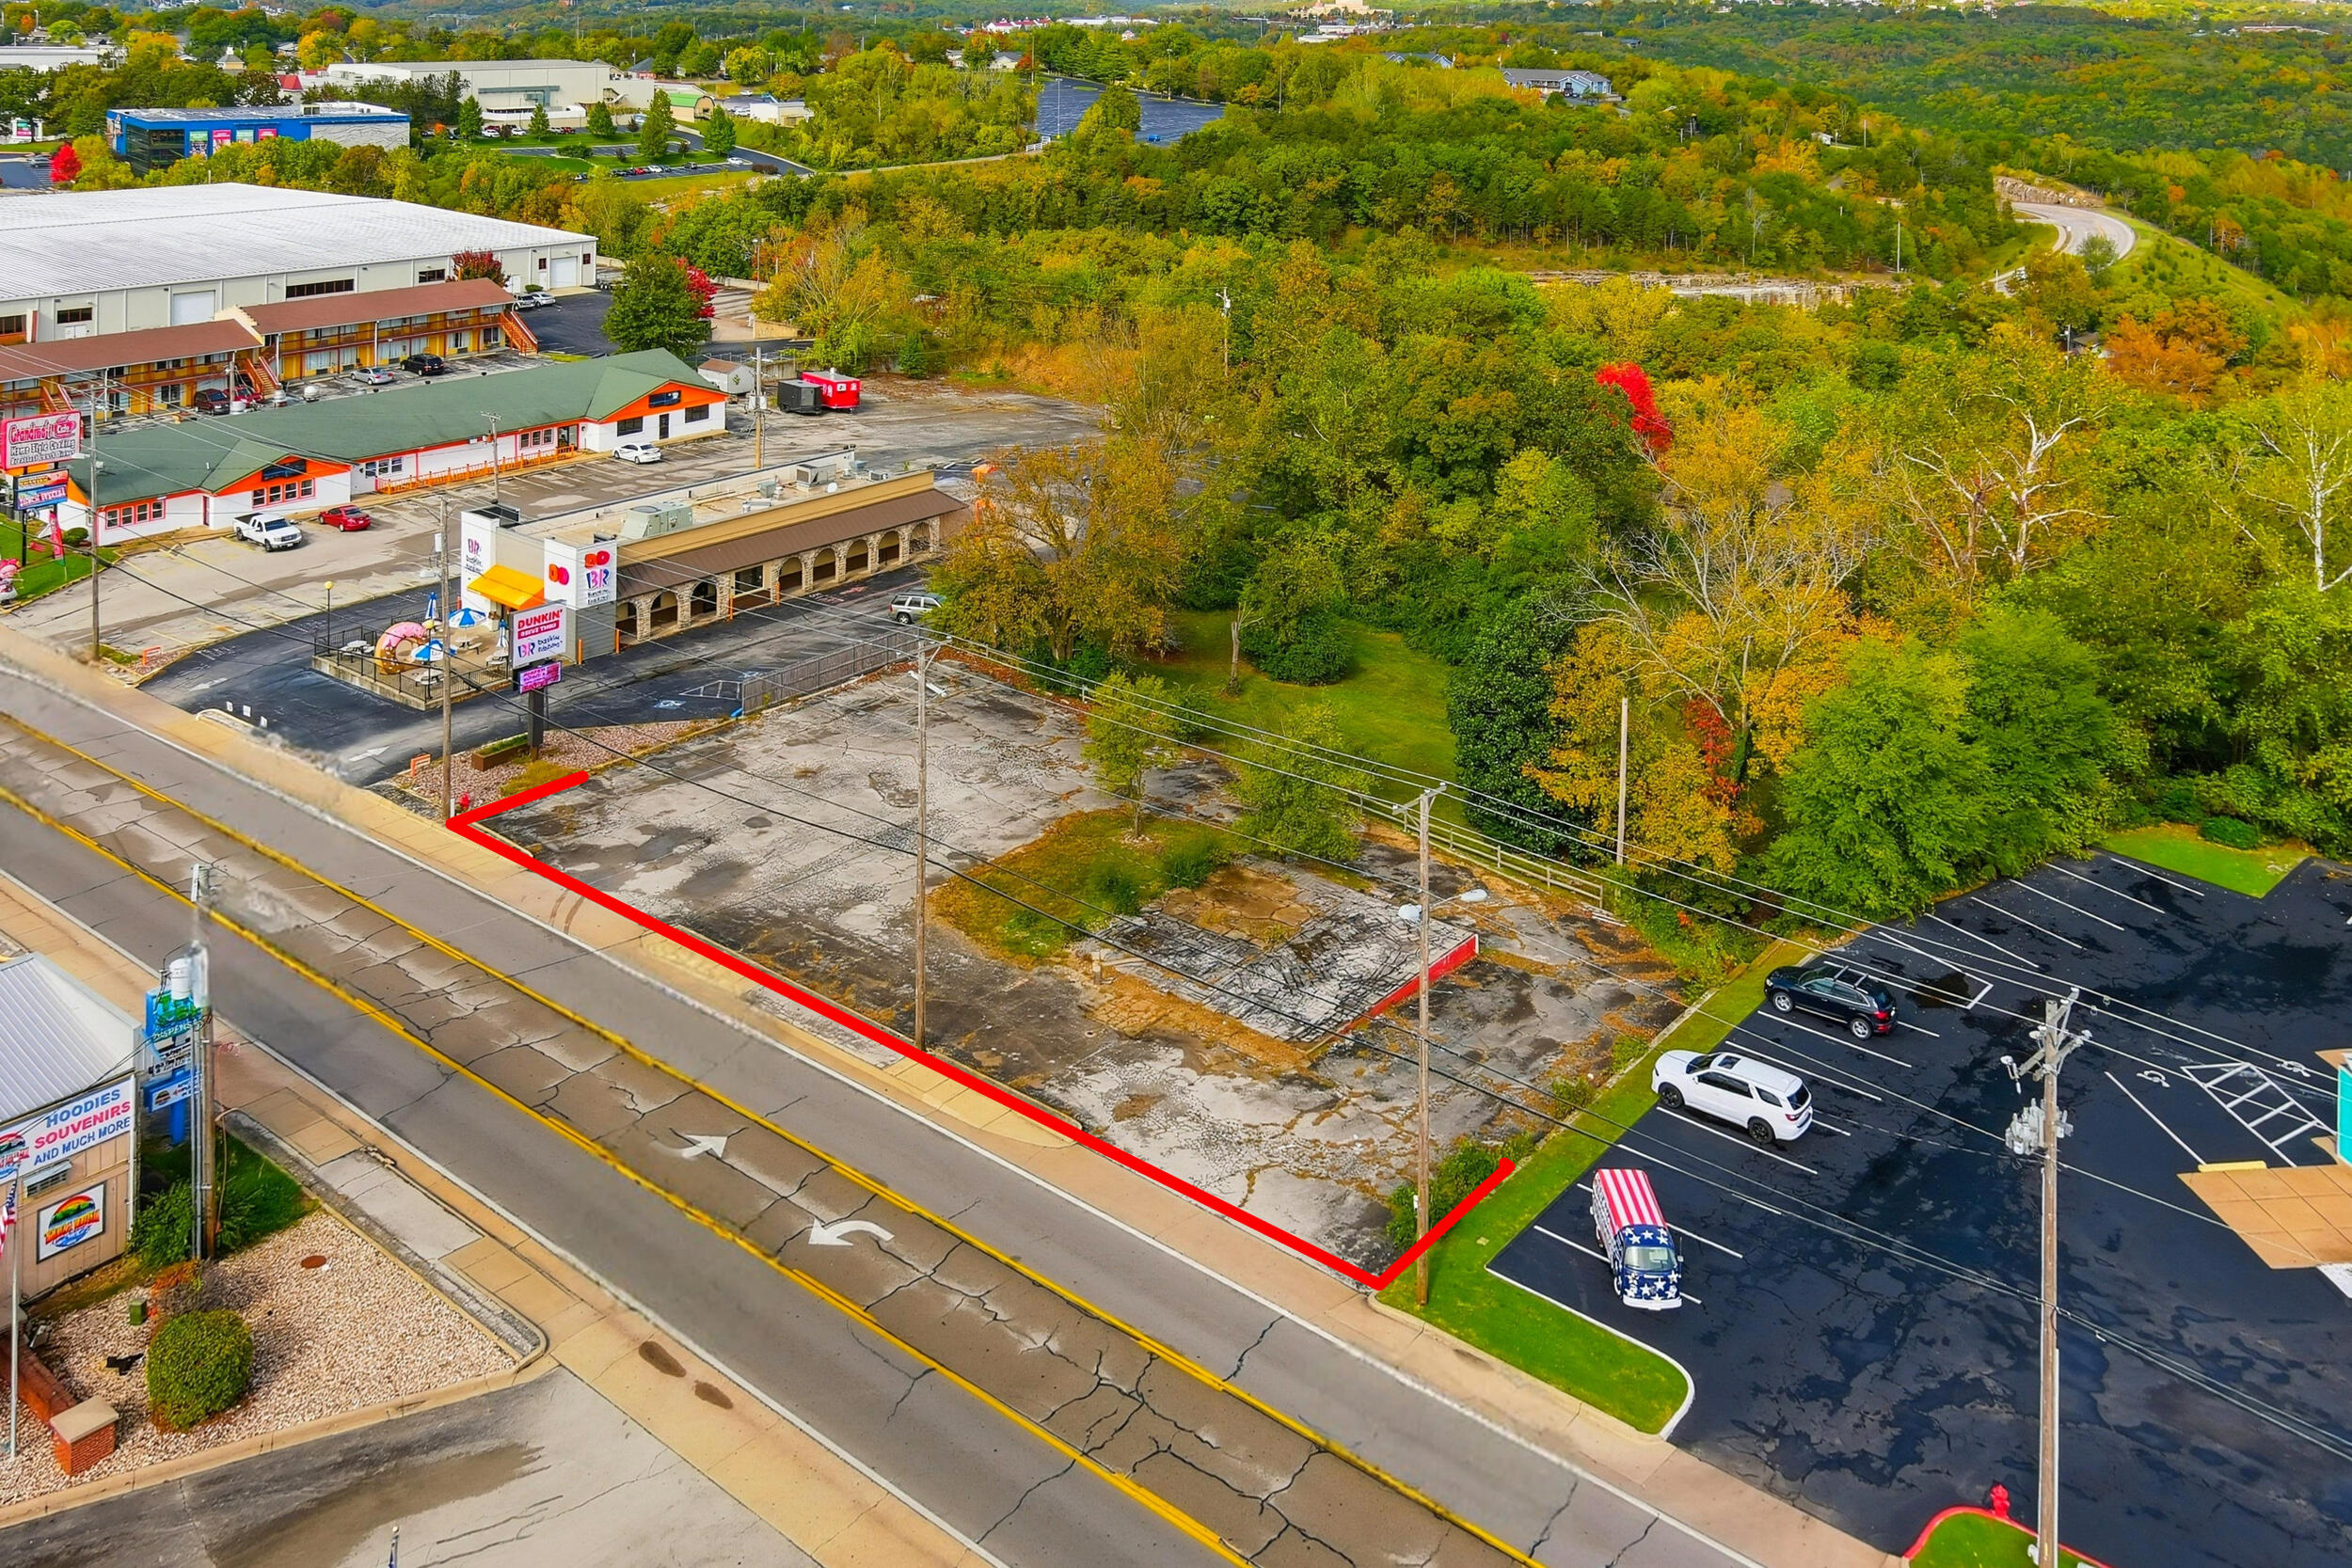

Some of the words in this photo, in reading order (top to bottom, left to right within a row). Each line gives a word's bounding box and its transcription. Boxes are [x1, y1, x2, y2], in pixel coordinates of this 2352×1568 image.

[518, 609, 563, 629] DUNKIN'
[35, 1101, 131, 1148] SOUVENIRS
[46, 1089, 120, 1128] HOODIES
[34, 1148, 58, 1165] AND
[62, 1132, 95, 1153] MUCH
[99, 1117, 131, 1138] MORE
